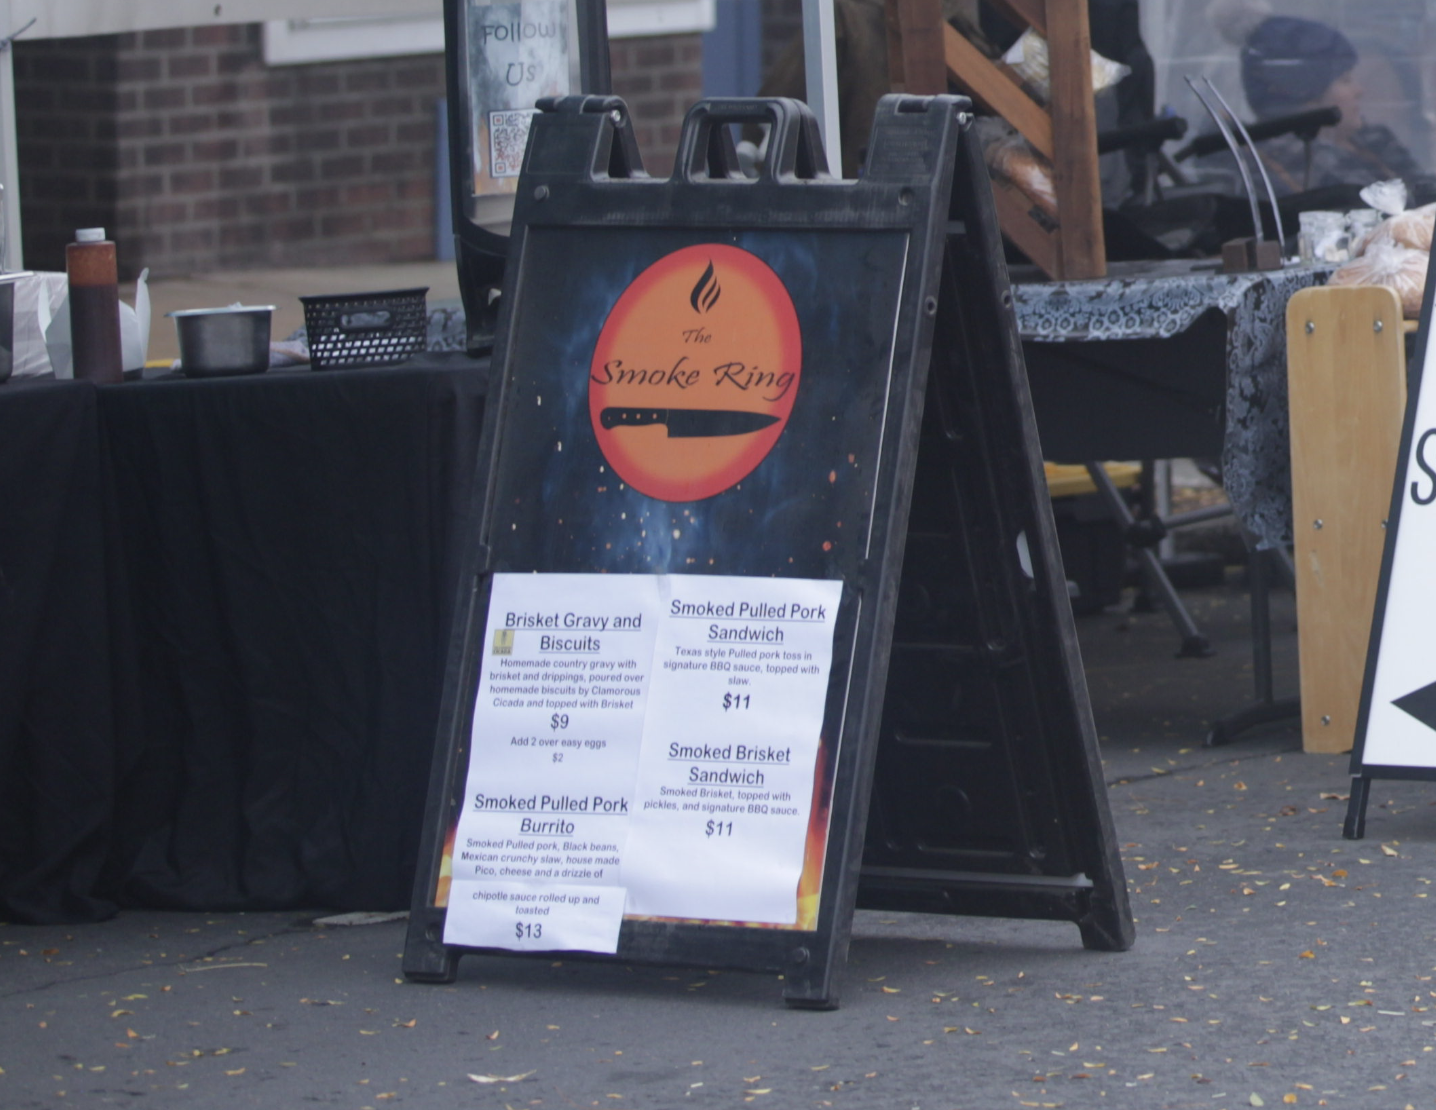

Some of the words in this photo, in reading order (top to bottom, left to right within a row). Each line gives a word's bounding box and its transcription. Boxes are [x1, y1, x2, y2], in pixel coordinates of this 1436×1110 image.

[682, 327, 712, 344] The
[591, 356, 700, 389] Smoke
[713, 362, 795, 402] Ring
[671, 599, 735, 617] Smoked
[739, 602, 786, 618] Pulled
[790, 603, 826, 619] Pork
[505, 611, 559, 628] Brisket
[564, 612, 609, 632] Gravy
[613, 613, 642, 629] and
[708, 624, 784, 641] Sandwich
[540, 635, 601, 652] Biscuits
[675, 646, 701, 656] Texas
[704, 648, 726, 659] style
[728, 648, 757, 659] Pulled
[759, 650, 780, 661] pork
[783, 651, 801, 660] toss
[804, 651, 812, 661] in
[500, 658, 551, 669] Homemade
[553, 659, 588, 670] country
[589, 661, 615, 671] gravy
[617, 659, 637, 669] with
[663, 660, 707, 671] signature
[710, 661, 731, 672] BBQ
[766, 664, 798, 675] topped
[800, 665, 820, 674] with
[489, 671, 521, 681] brisket
[523, 672, 539, 681] and
[589, 673, 621, 683] poured
[489, 685, 539, 695] homemade
[542, 685, 576, 695] biscuits
[578, 686, 589, 697] by
[591, 686, 641, 696] Clamorous
[493, 697, 524, 707] Cicada
[527, 698, 543, 708] and
[546, 699, 577, 710] topped
[580, 699, 599, 709] with
[601, 700, 634, 709] Brisket
[722, 691, 750, 712] $11
[550, 713, 569, 731] $9
[511, 737, 529, 746] Add
[531, 737, 537, 746] 2
[539, 739, 558, 747] over
[561, 740, 582, 749] easy
[585, 740, 606, 749] eggs
[552, 752, 564, 764] $2
[669, 742, 731, 760] Smoked
[736, 745, 791, 762] Brisket
[689, 766, 764, 784] Sandwich
[660, 786, 697, 797] Smoked
[737, 790, 769, 802] topped
[772, 791, 791, 801] with
[474, 793, 536, 810] Smoked
[541, 795, 588, 811] Pulled
[593, 796, 628, 812] Pork
[682, 801, 700, 811] and
[702, 802, 745, 814] signature
[747, 804, 769, 815] BBQ
[520, 818, 575, 834] Burrito
[705, 819, 733, 838] $11
[466, 838, 503, 848] Smoked
[506, 840, 534, 850] Pulled
[563, 841, 587, 851] Black
[461, 852, 498, 862] Mexican
[501, 853, 538, 865] crunchy
[566, 854, 592, 864] house
[595, 856, 620, 865] made
[499, 867, 532, 876] cheese
[534, 867, 552, 877] and
[561, 868, 591, 878] drizzle
[594, 869, 603, 878] of
[472, 891, 507, 903] chipotle
[510, 893, 537, 901] sauce
[538, 893, 566, 903] rolled
[568, 895, 580, 905] up
[582, 895, 599, 904] and
[515, 906, 549, 915] toasted
[515, 921, 542, 941] $13
